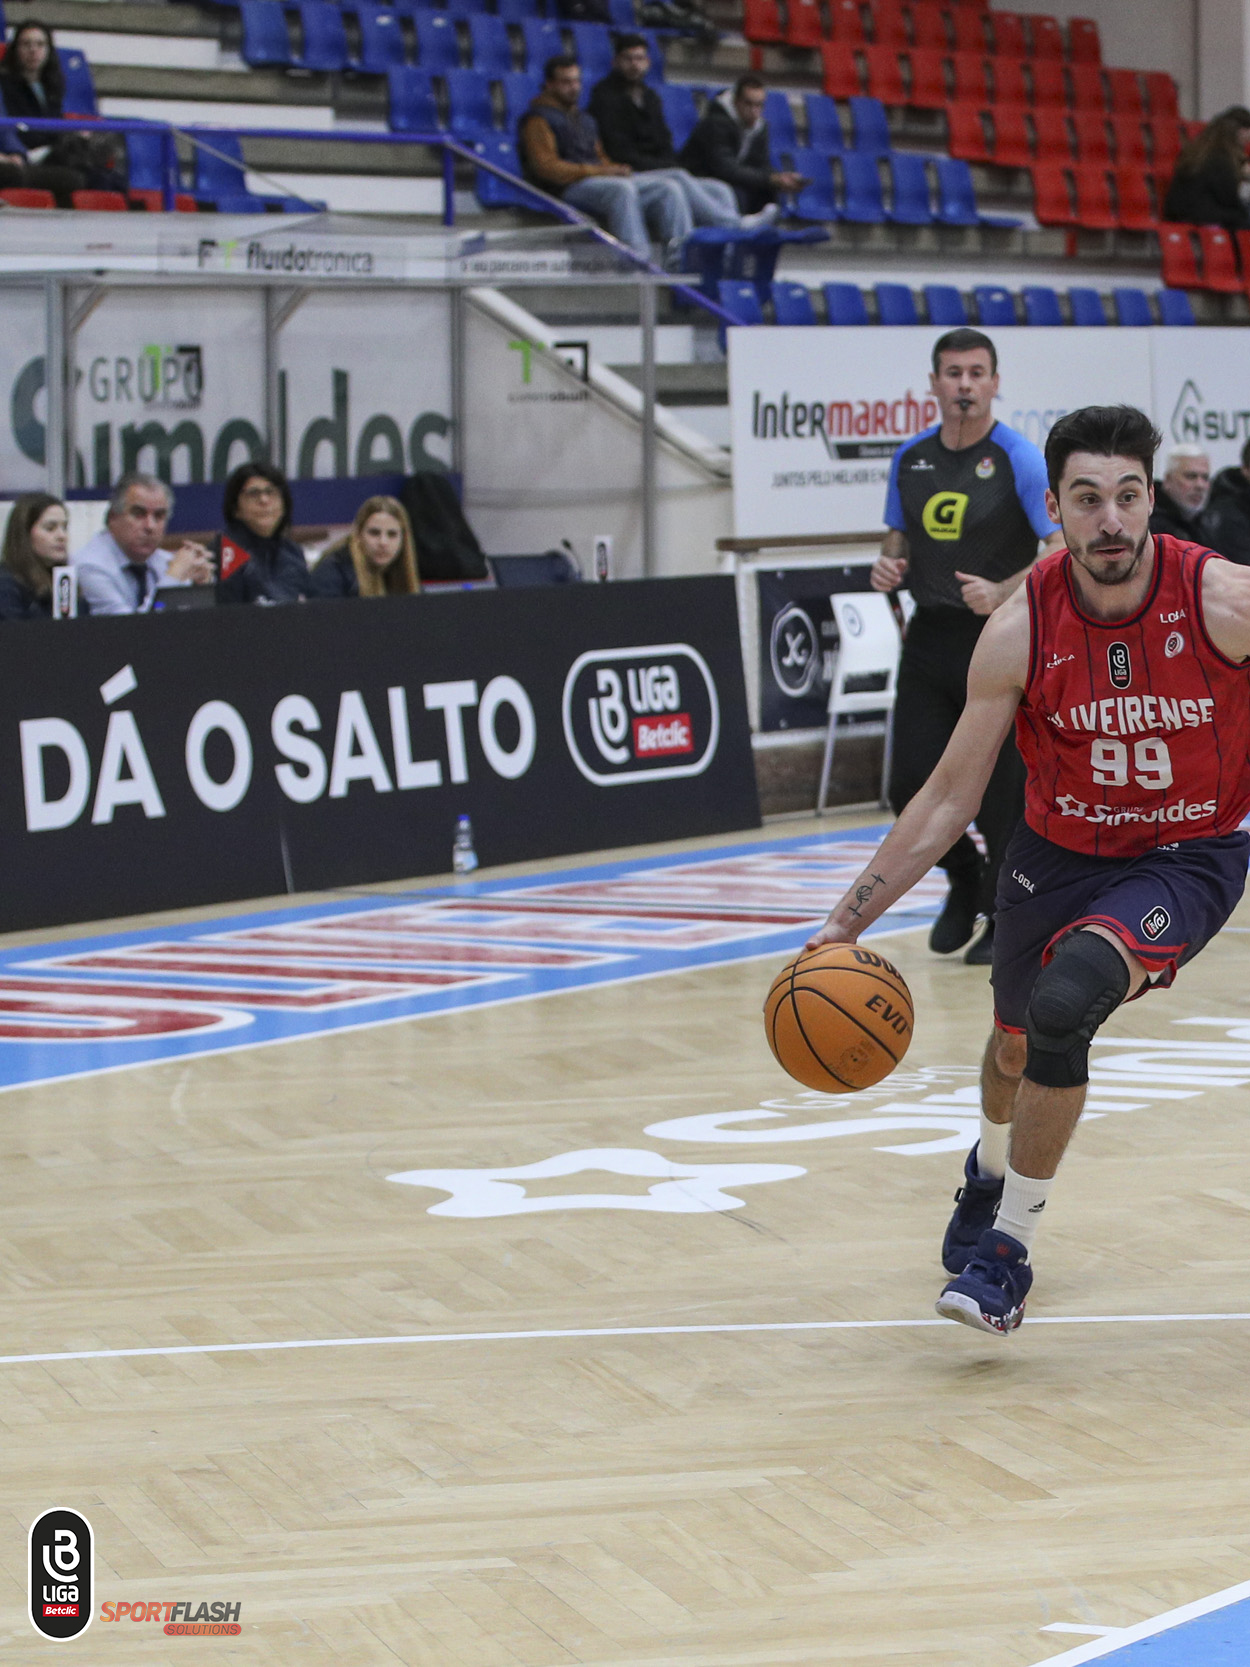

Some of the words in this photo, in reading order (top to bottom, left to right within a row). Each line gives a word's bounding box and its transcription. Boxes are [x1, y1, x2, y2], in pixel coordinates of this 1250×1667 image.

[1160, 608, 1186, 624] LOBA
[19, 664, 166, 833] DÁ
[185, 700, 253, 812] O
[270, 675, 537, 803] SALTO
[637, 719, 690, 752] Betclic
[1090, 737, 1174, 790] 99
[1012, 869, 1036, 894] LOBA
